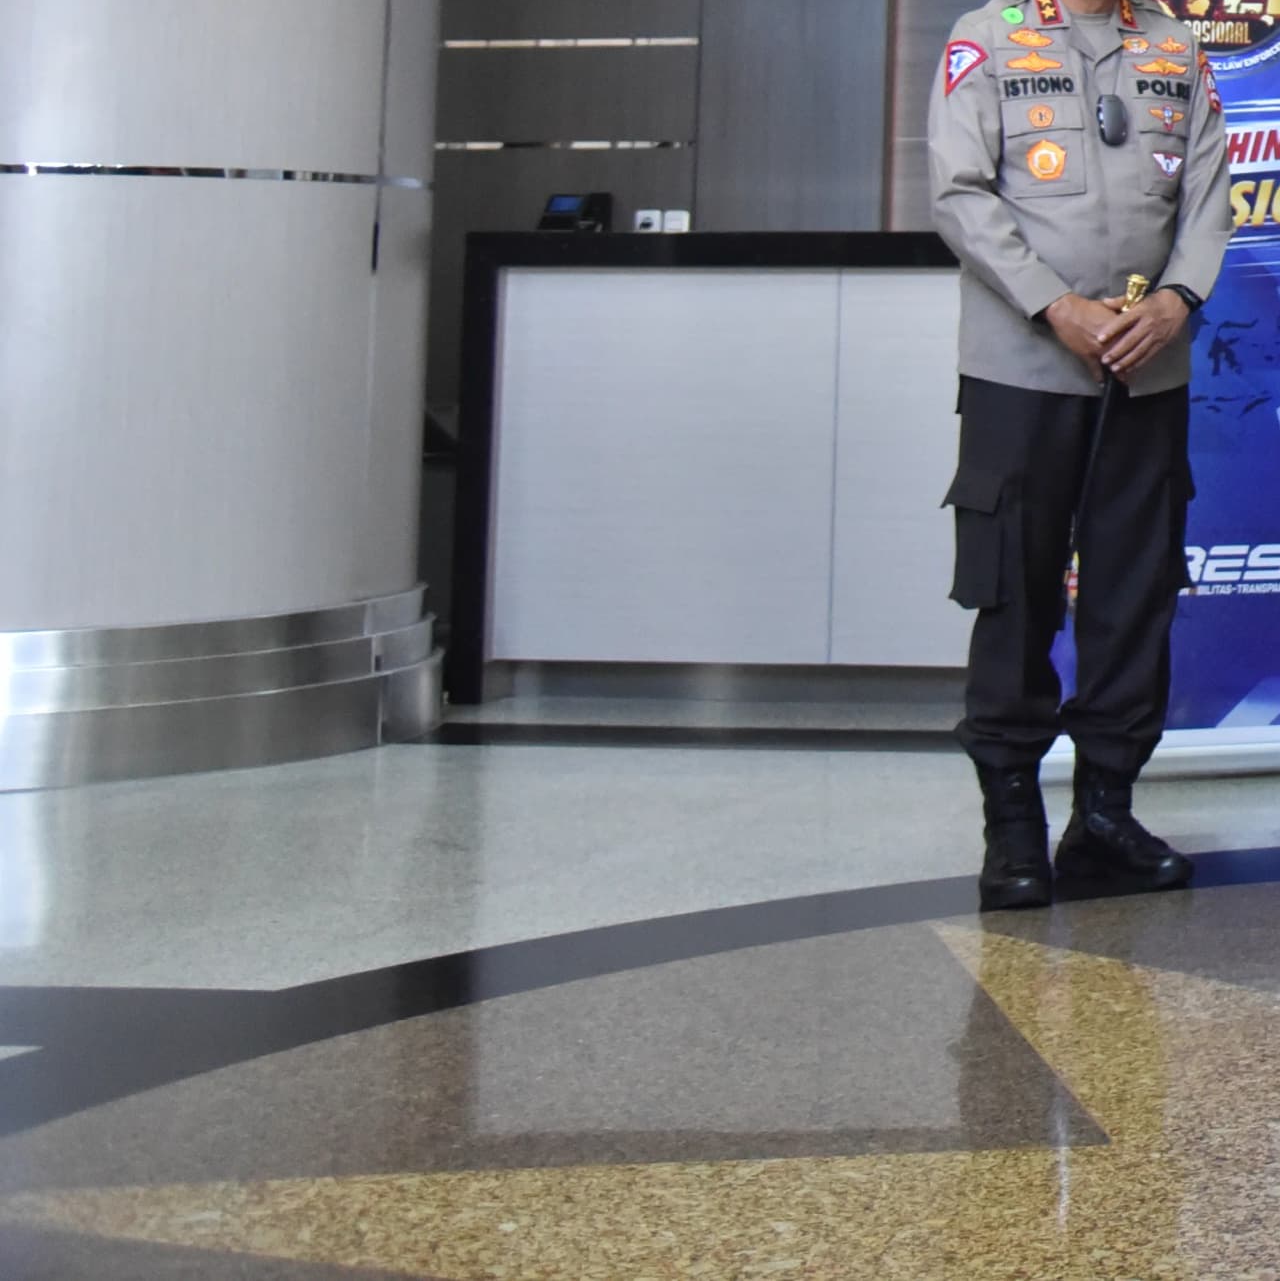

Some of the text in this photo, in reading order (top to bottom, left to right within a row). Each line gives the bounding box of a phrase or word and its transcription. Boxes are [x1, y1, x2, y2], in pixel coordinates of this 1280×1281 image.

[1184, 19, 1252, 44] ASIONAL
[1004, 77, 1074, 97] ISTIONO
[1137, 79, 1191, 101] POLRI
